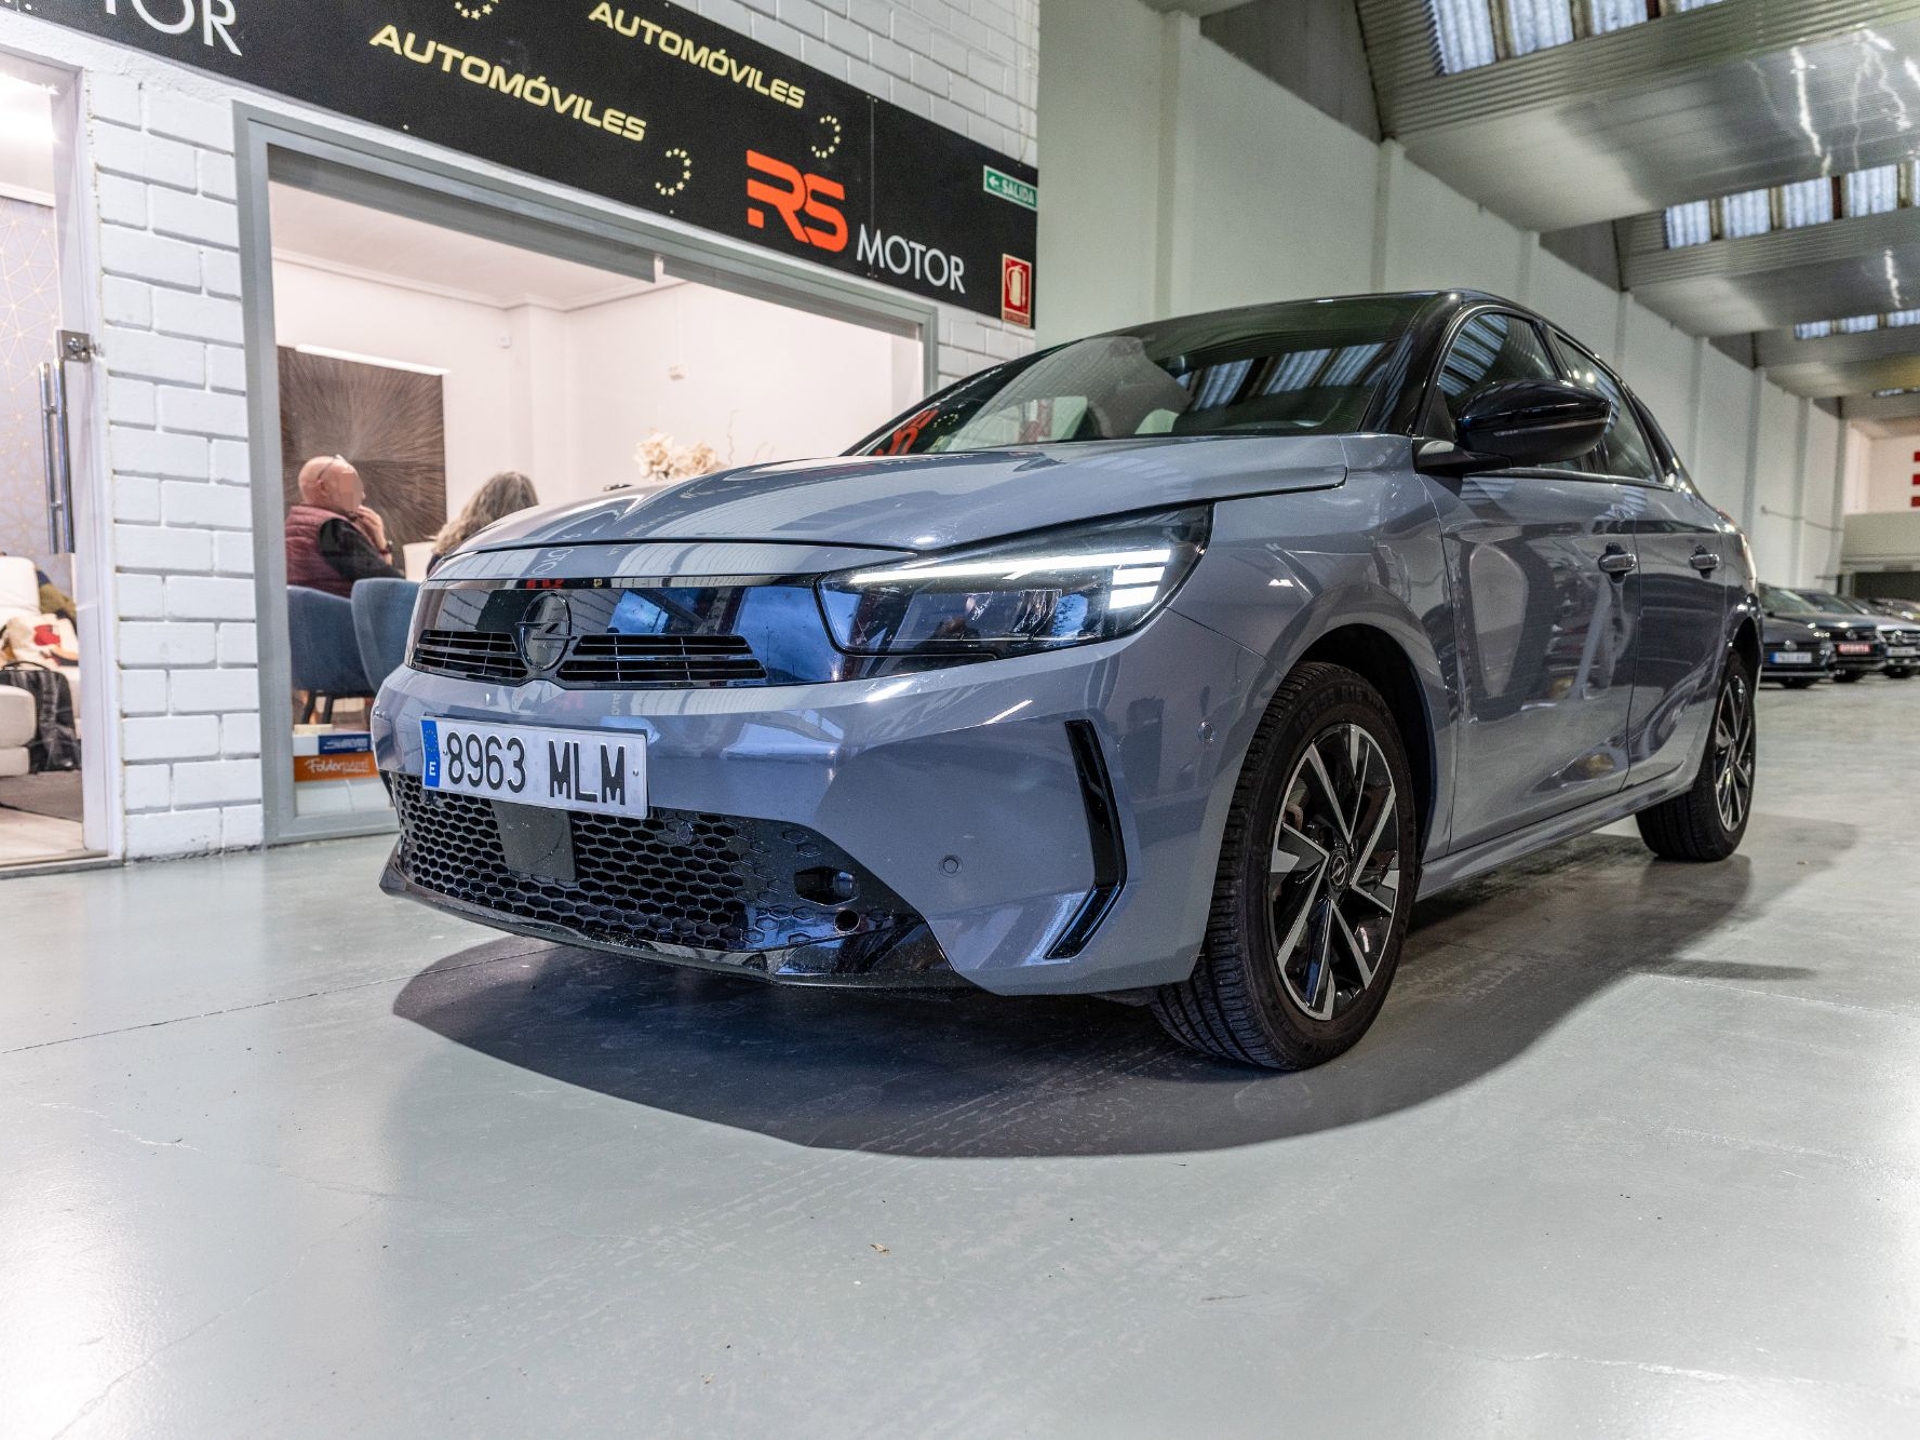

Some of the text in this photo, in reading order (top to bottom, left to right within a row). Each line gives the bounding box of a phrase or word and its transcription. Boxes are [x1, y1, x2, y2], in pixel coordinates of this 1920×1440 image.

[369, 24, 647, 142] AUTOMÓVILES
[588, 2, 806, 110] AUTOMÓVILES
[746, 149, 966, 294] RS MOTOR
[1002, 178, 1035, 205] SALIDA
[429, 761, 437, 777] E
[446, 731, 627, 806] 8963 MLM
